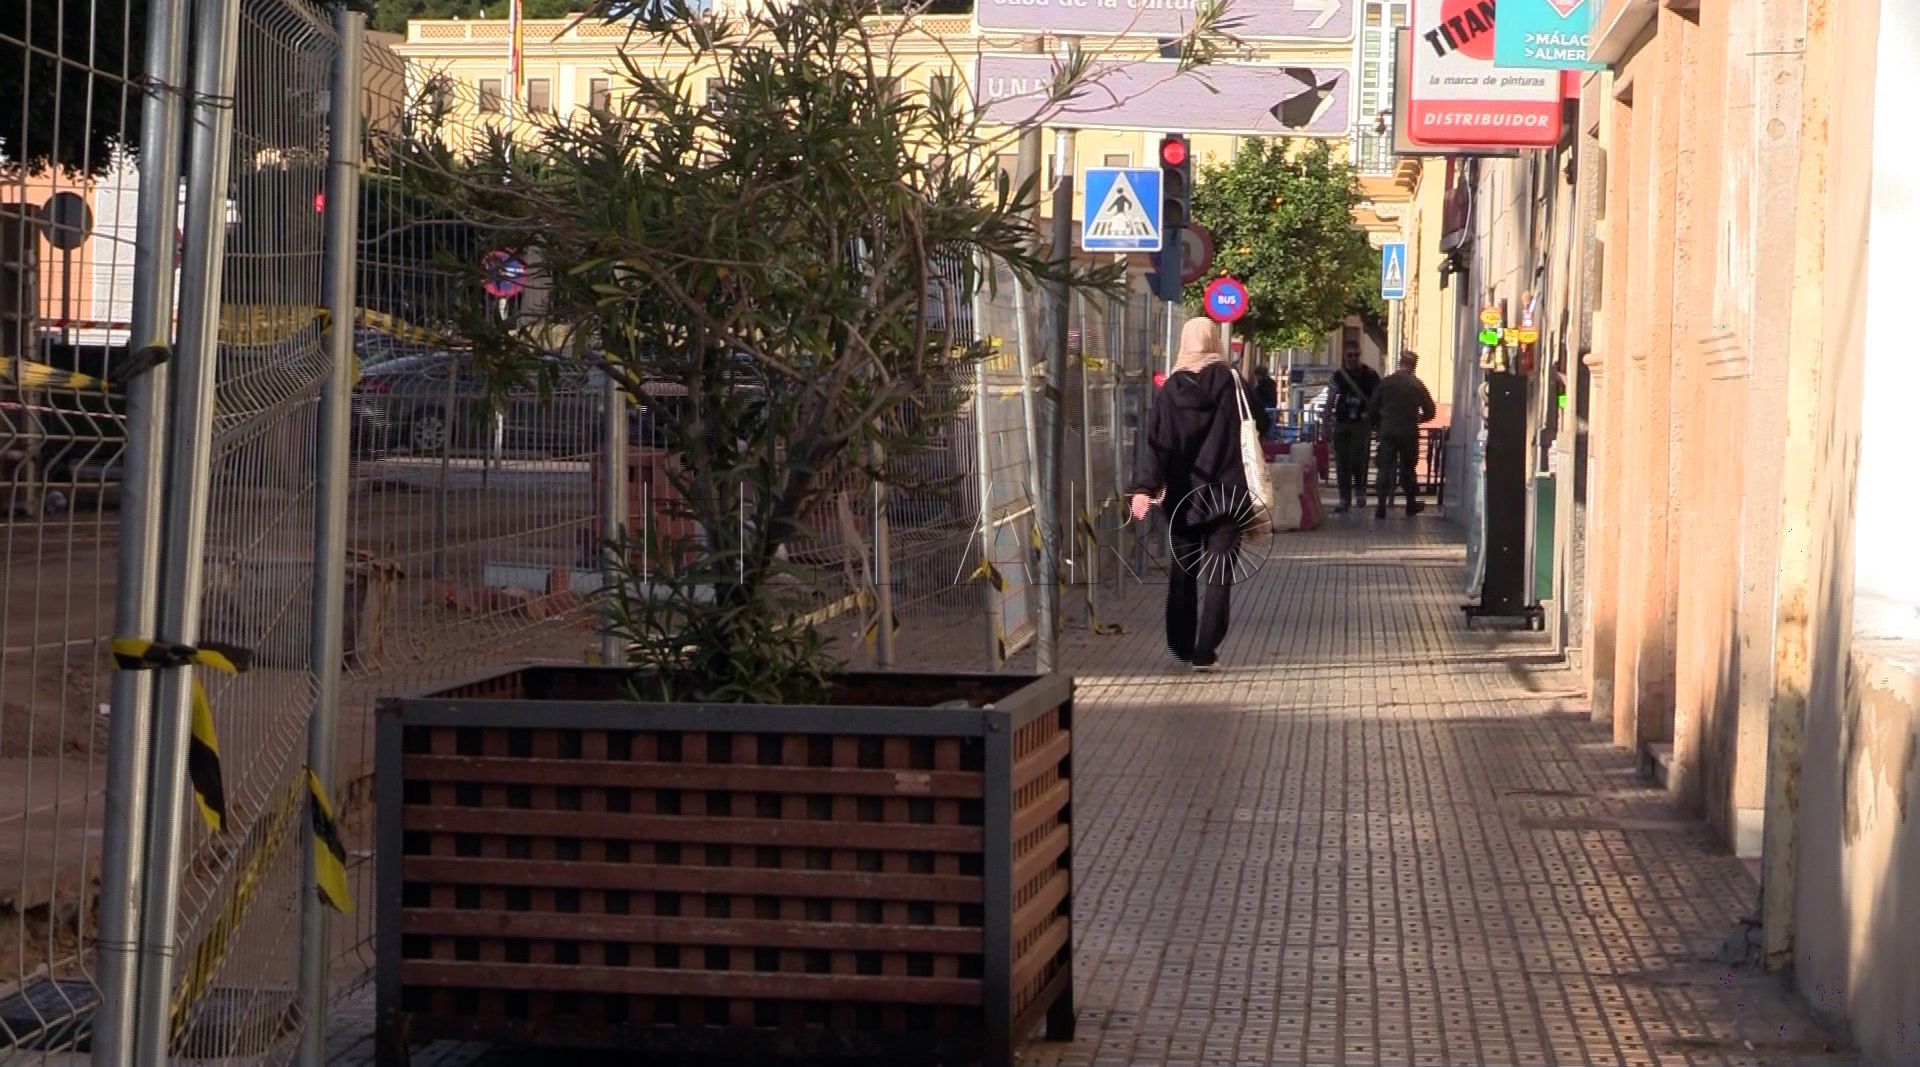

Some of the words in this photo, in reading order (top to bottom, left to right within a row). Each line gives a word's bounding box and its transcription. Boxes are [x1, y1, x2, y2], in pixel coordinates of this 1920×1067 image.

[1423, 0, 1496, 57] TITAN
[1535, 47, 1586, 61] ALMER
[1429, 76, 1440, 85] la
[1444, 77, 1479, 85] marca
[1483, 76, 1497, 85] de
[1500, 76, 1545, 87] pinturas
[1424, 113, 1549, 126] DISTRIBUIDOR
[1218, 295, 1236, 304] BUS
